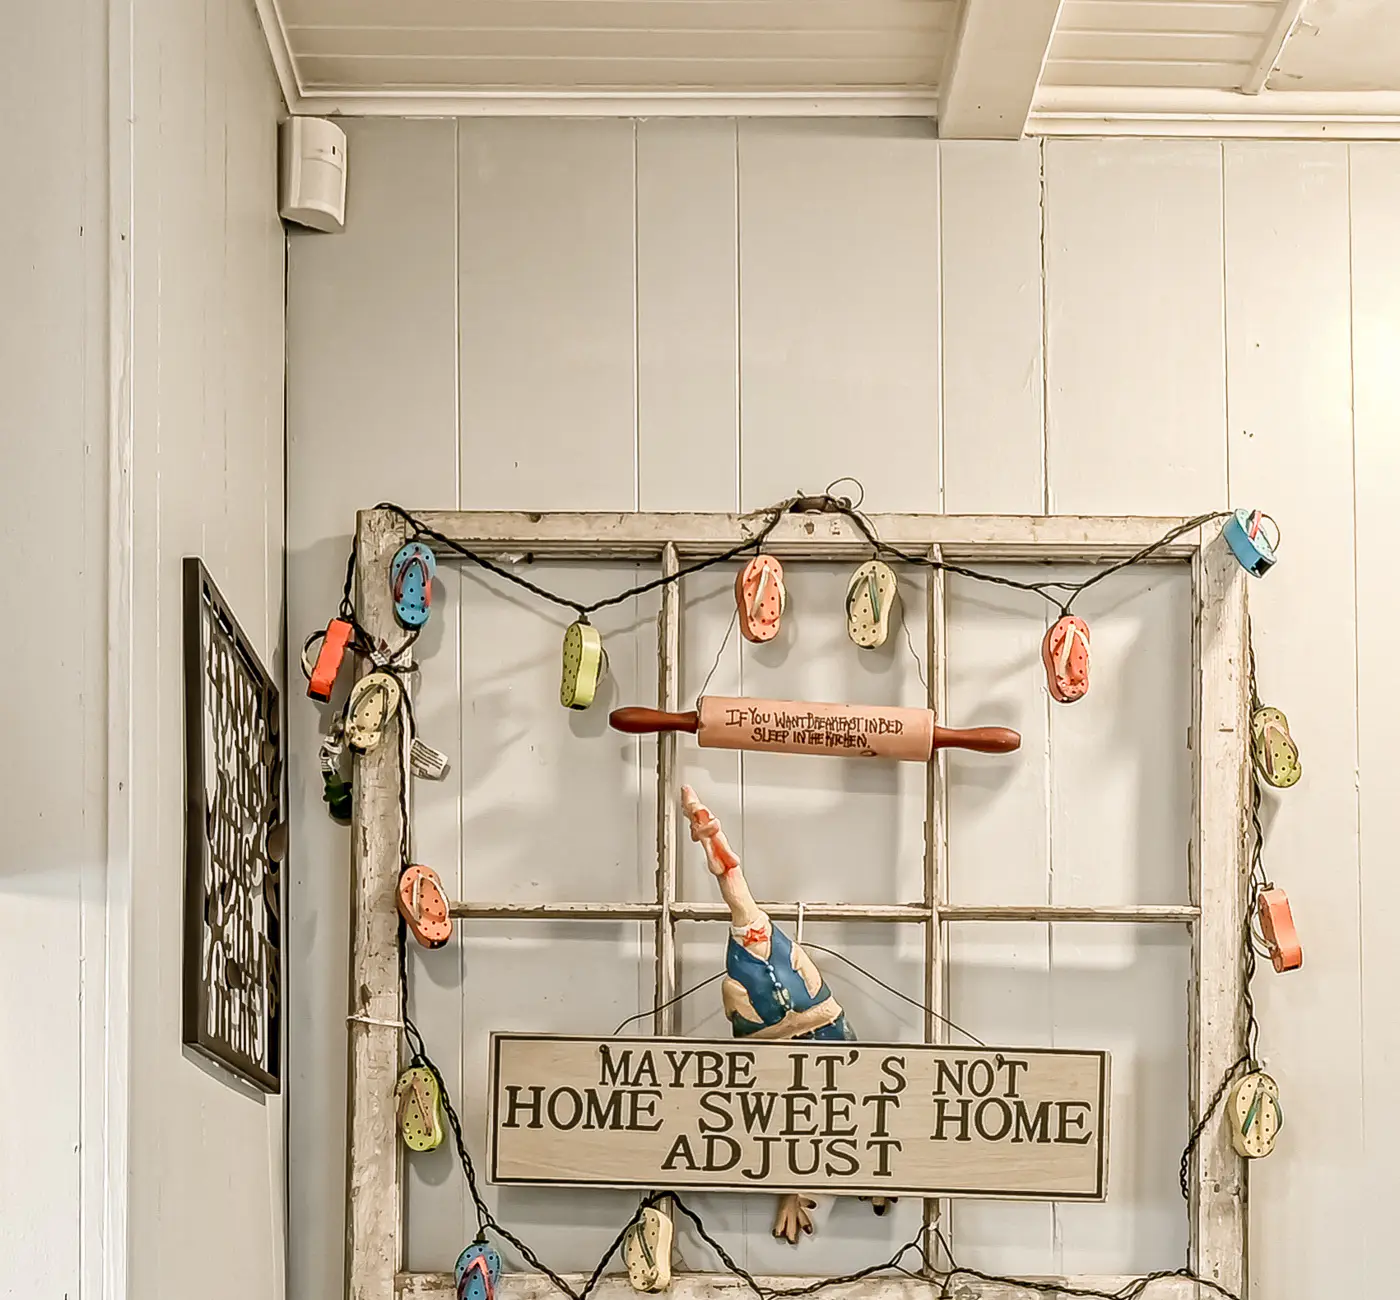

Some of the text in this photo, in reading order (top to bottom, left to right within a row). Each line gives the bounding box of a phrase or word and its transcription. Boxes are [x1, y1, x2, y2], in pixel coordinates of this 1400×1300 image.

[725, 709, 748, 727] IF
[865, 718, 878, 733] IN
[751, 727, 789, 743] SLEEP
[793, 730, 806, 744] IN
[805, 729, 825, 745] THE
[599, 1048, 757, 1089] MAYBE
[933, 1058, 1028, 1098] NOT
[502, 1086, 1093, 1144] HOME SWEET HOME
[661, 1134, 902, 1179] ADJUST
